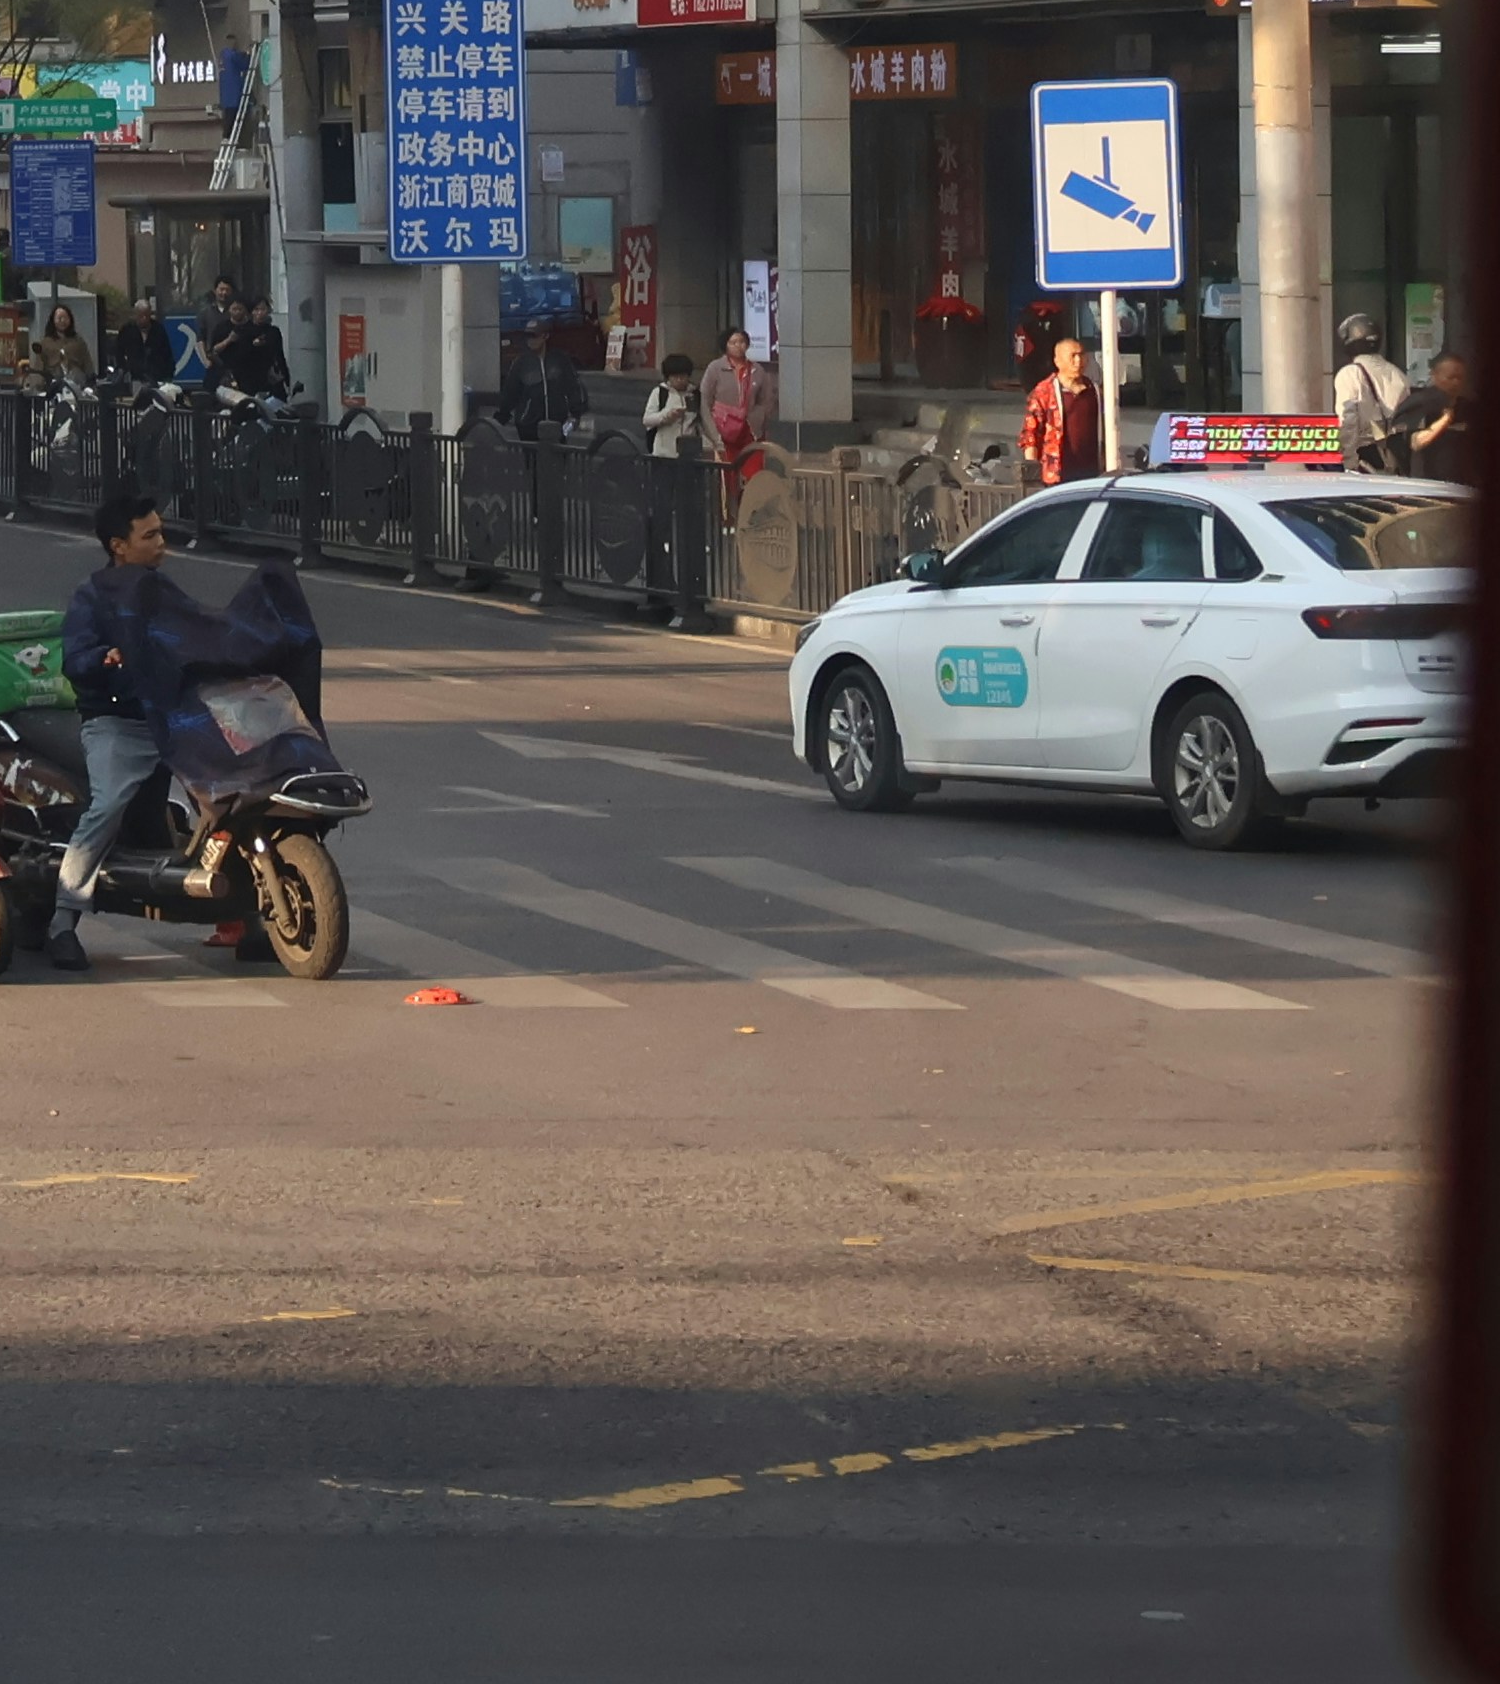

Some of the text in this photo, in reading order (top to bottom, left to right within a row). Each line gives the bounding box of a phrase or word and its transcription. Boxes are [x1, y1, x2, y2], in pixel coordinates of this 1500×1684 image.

[396, 0, 512, 36] 兴关路
[397, 42, 513, 79] 禁止停车
[851, 49, 947, 93] 水城羊肉粉
[397, 86, 514, 123] 停车请到
[398, 130, 515, 166] 政务中心
[398, 173, 516, 209] 浙江商贸城
[400, 217, 518, 253] 沃尔玛
